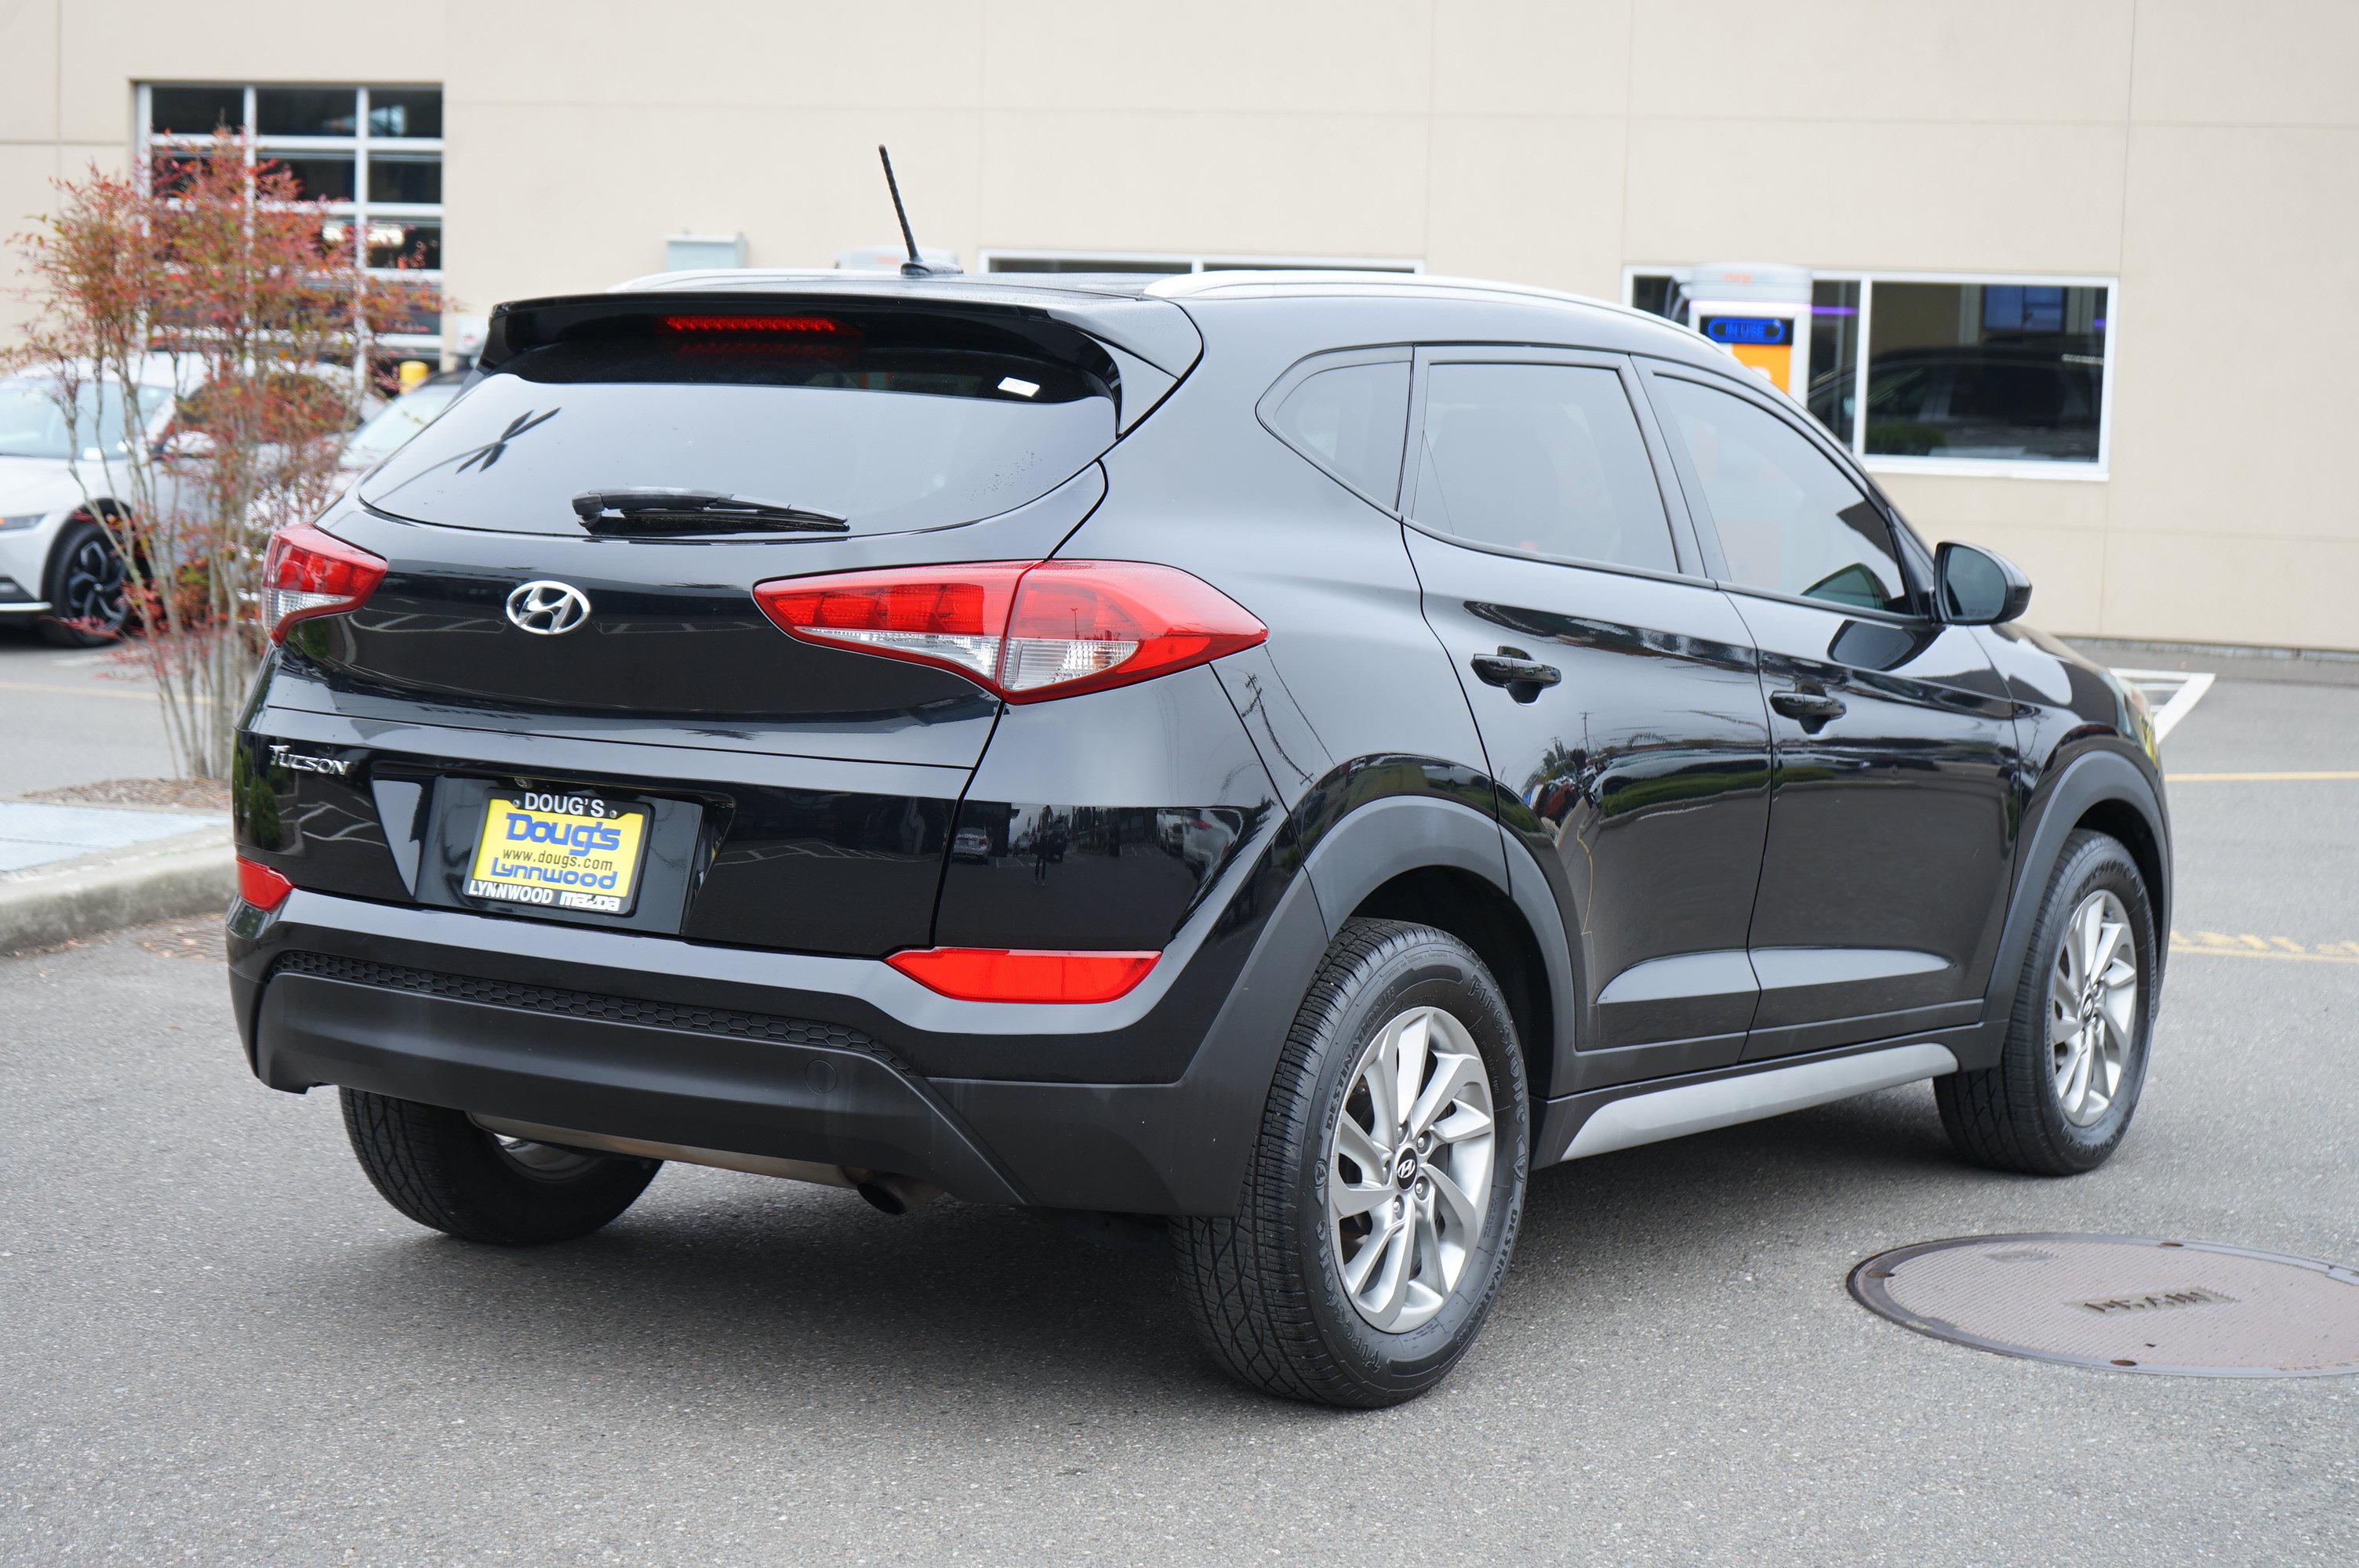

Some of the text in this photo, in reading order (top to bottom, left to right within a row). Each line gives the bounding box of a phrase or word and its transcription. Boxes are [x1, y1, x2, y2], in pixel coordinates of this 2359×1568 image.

[525, 793, 605, 817] DOUG'S
[506, 812, 621, 857] Doug's
[503, 848, 613, 871] www.dougs.com
[490, 858, 617, 889] Lynnwood
[468, 880, 554, 904] LYNNWOOD
